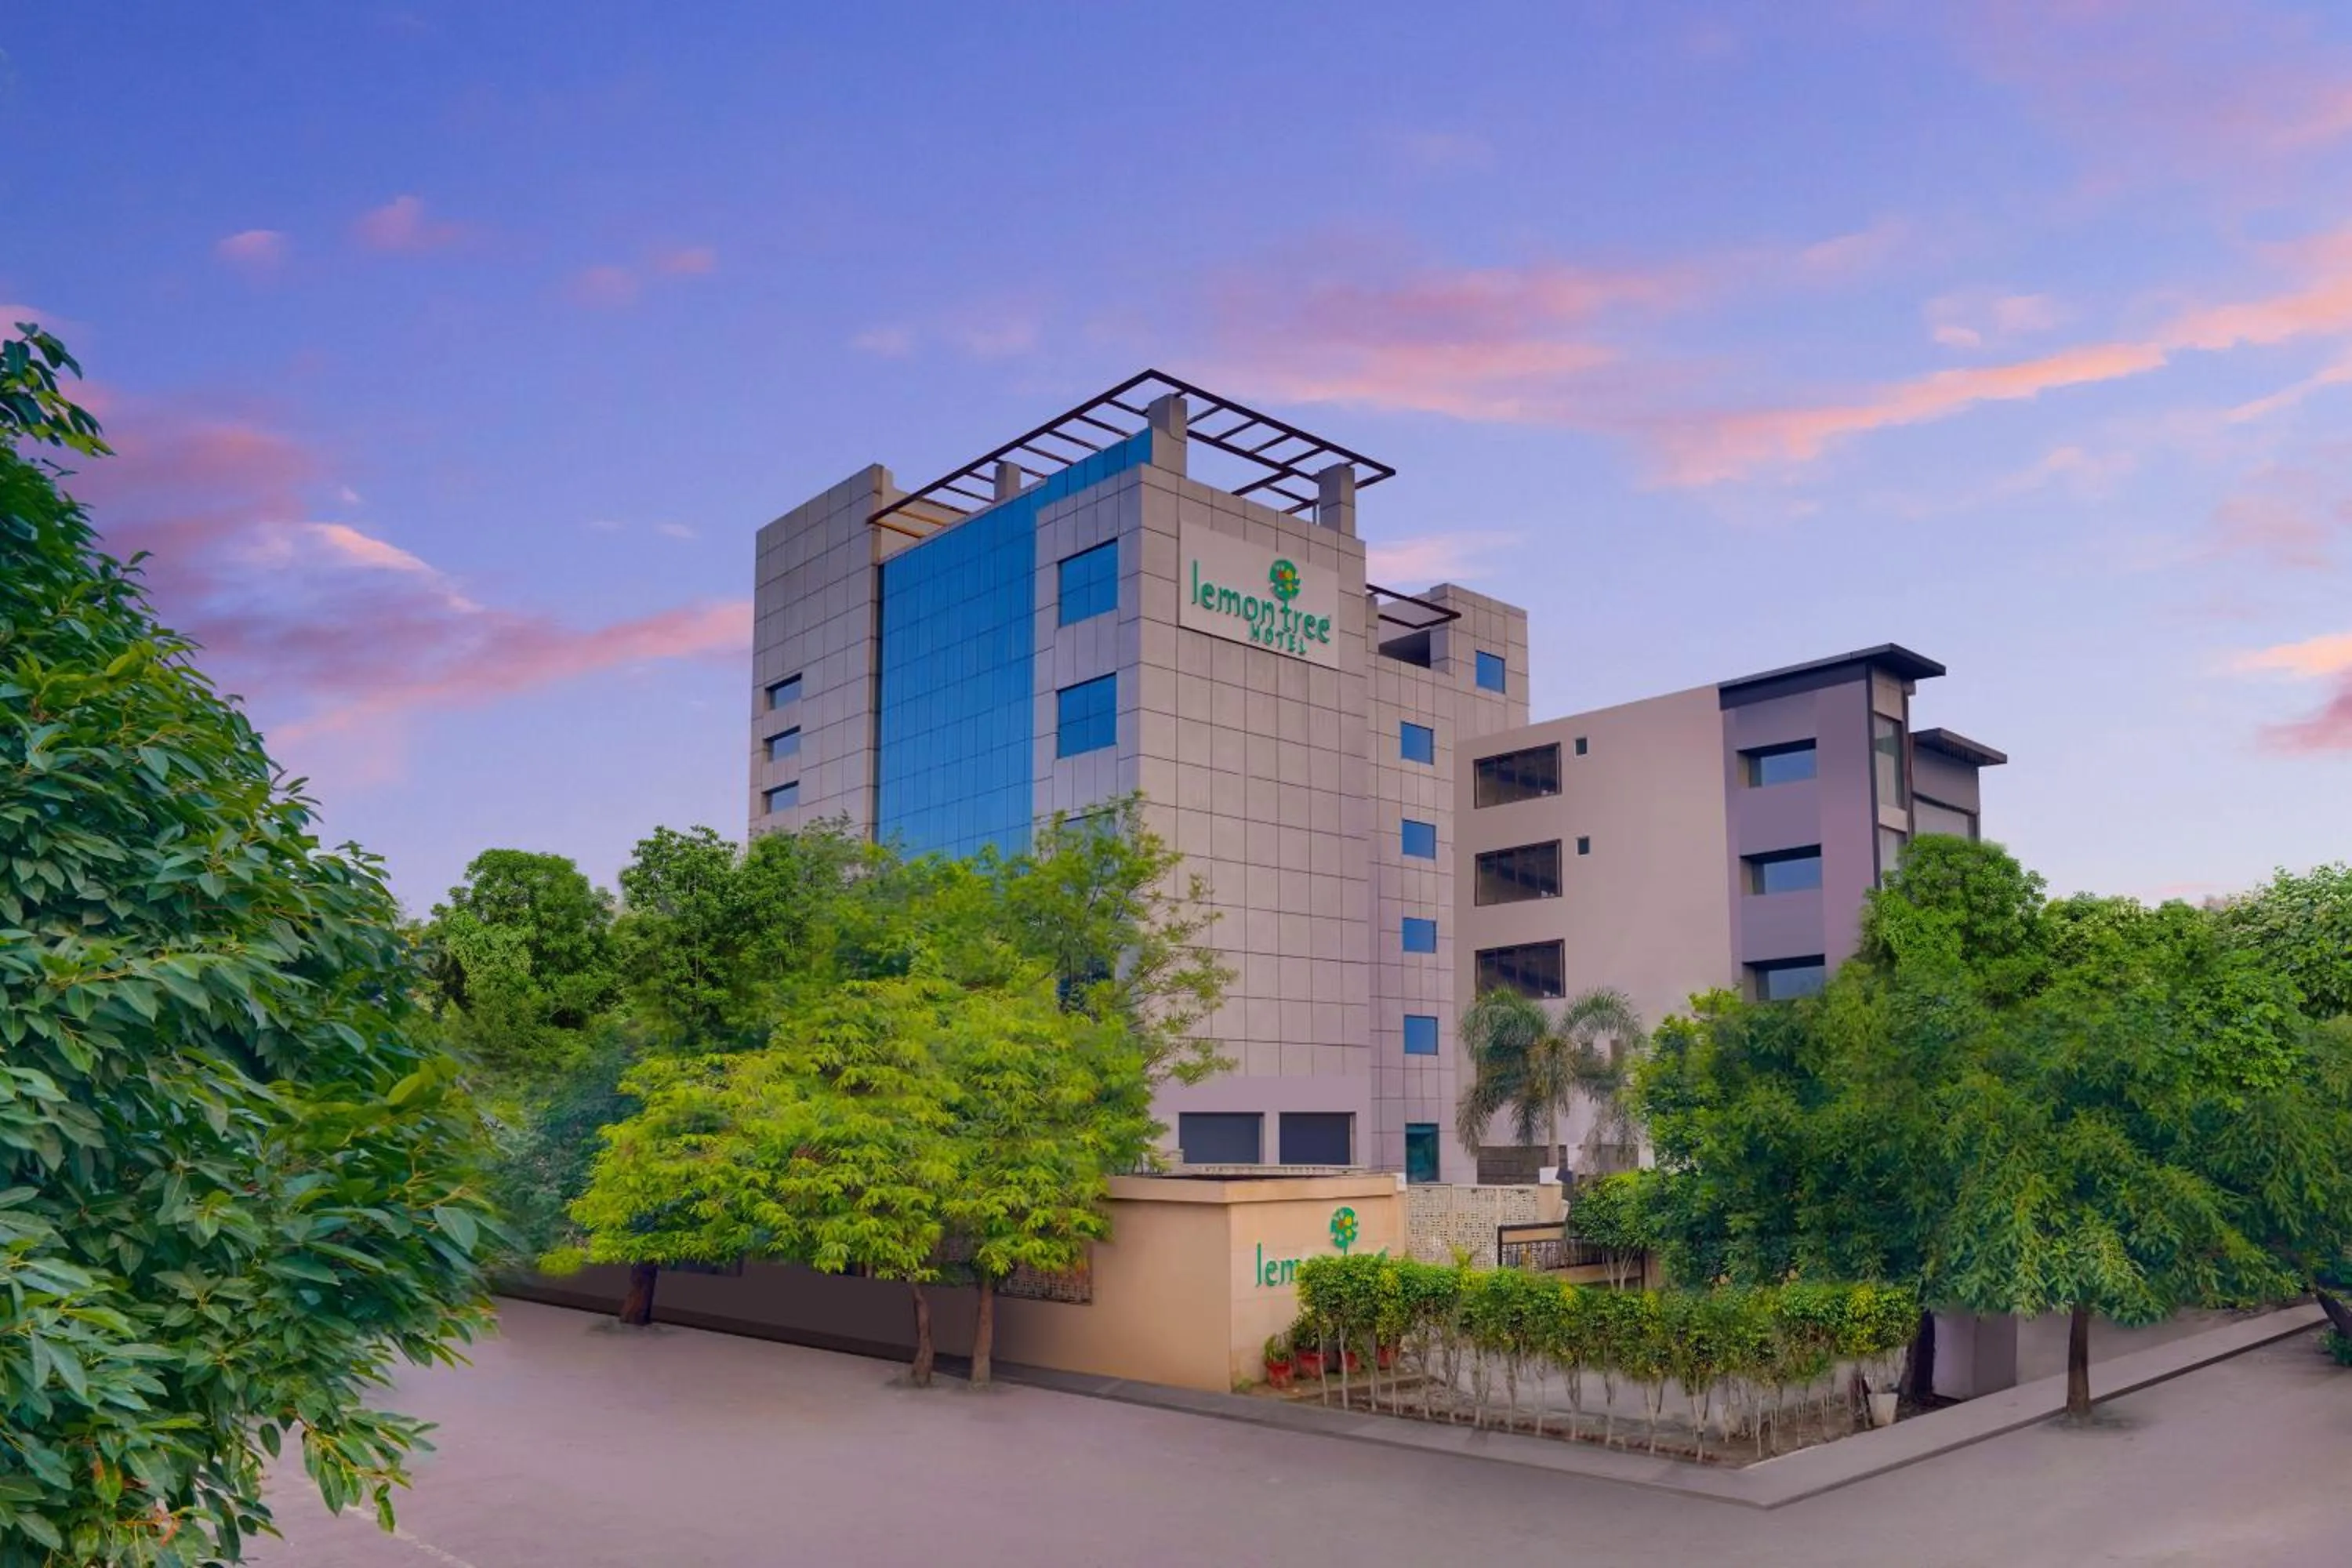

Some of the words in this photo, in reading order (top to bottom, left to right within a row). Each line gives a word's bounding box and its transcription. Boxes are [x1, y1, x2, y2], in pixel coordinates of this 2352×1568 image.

[1191, 559, 1275, 628] lemon
[1279, 601, 1331, 644] tree
[1250, 623, 1307, 655] HOTEL
[1255, 1243, 1301, 1287] lem
